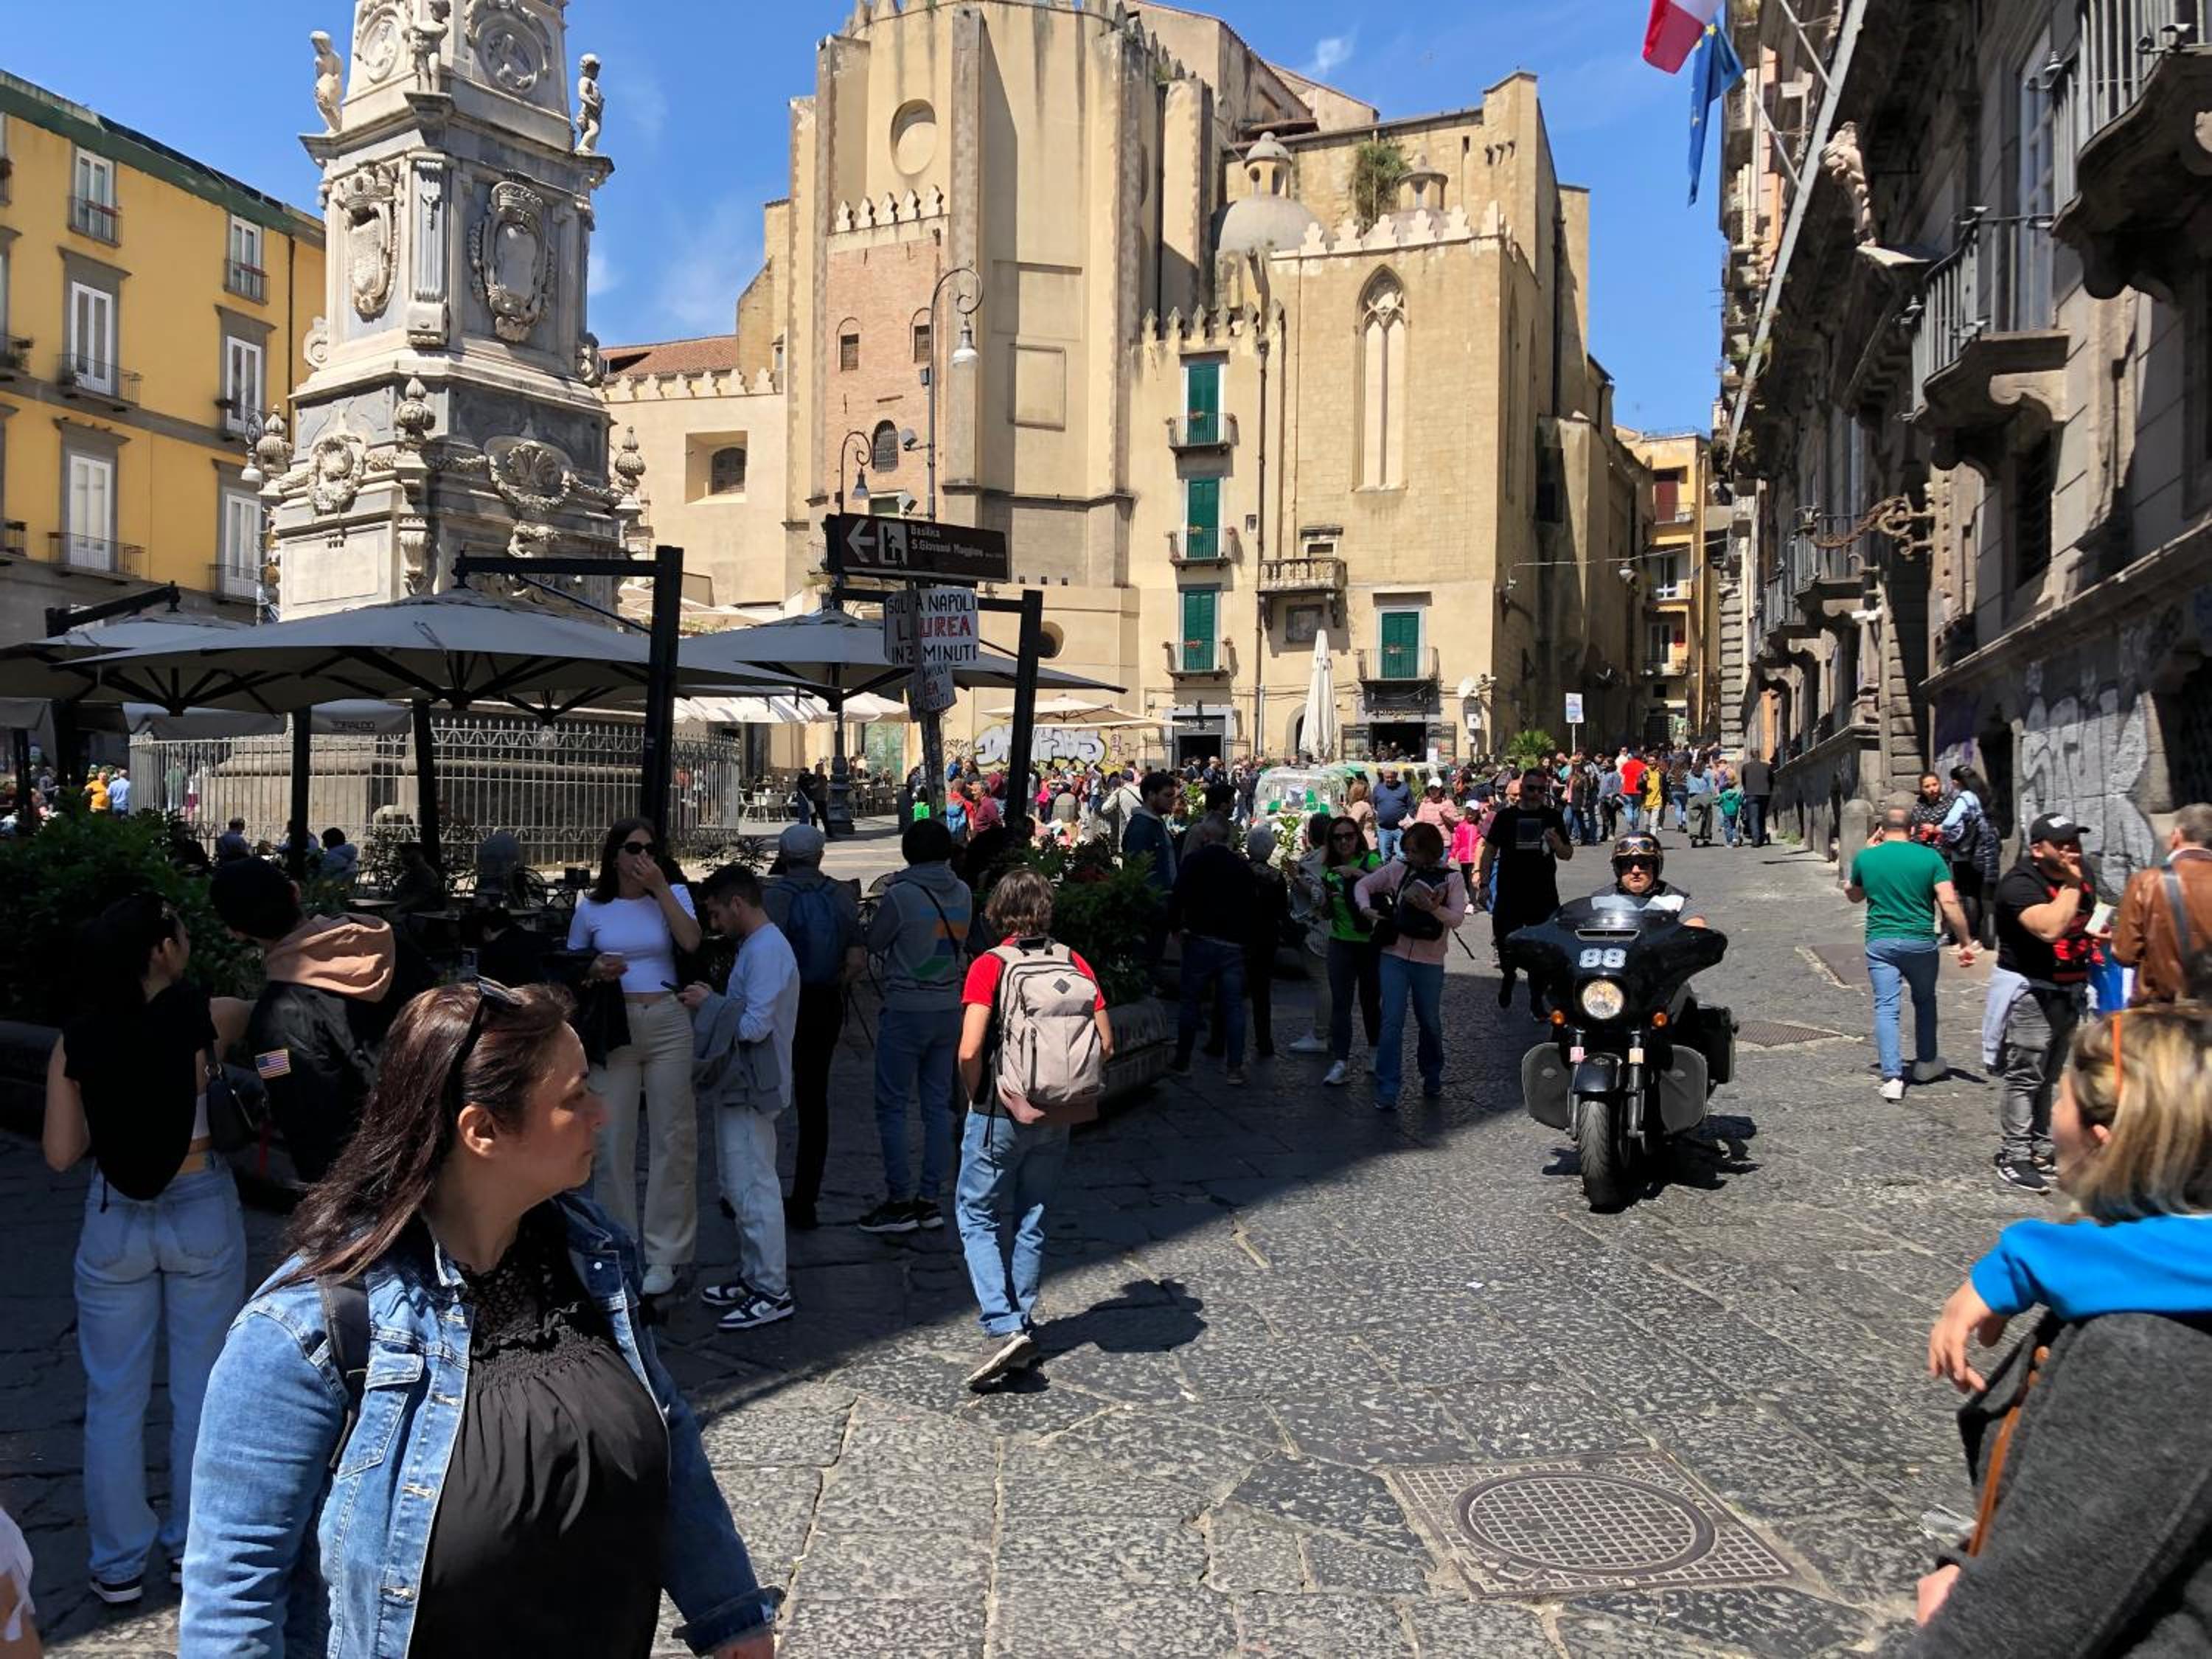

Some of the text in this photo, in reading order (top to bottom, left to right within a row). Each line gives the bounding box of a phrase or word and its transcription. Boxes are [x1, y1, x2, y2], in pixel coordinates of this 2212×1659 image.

[887, 597, 911, 614] SOL
[928, 593, 976, 612] NAPOLI
[897, 614, 972, 641] LUREA
[922, 643, 977, 663] MINUTI
[1579, 947, 1627, 968] 88
